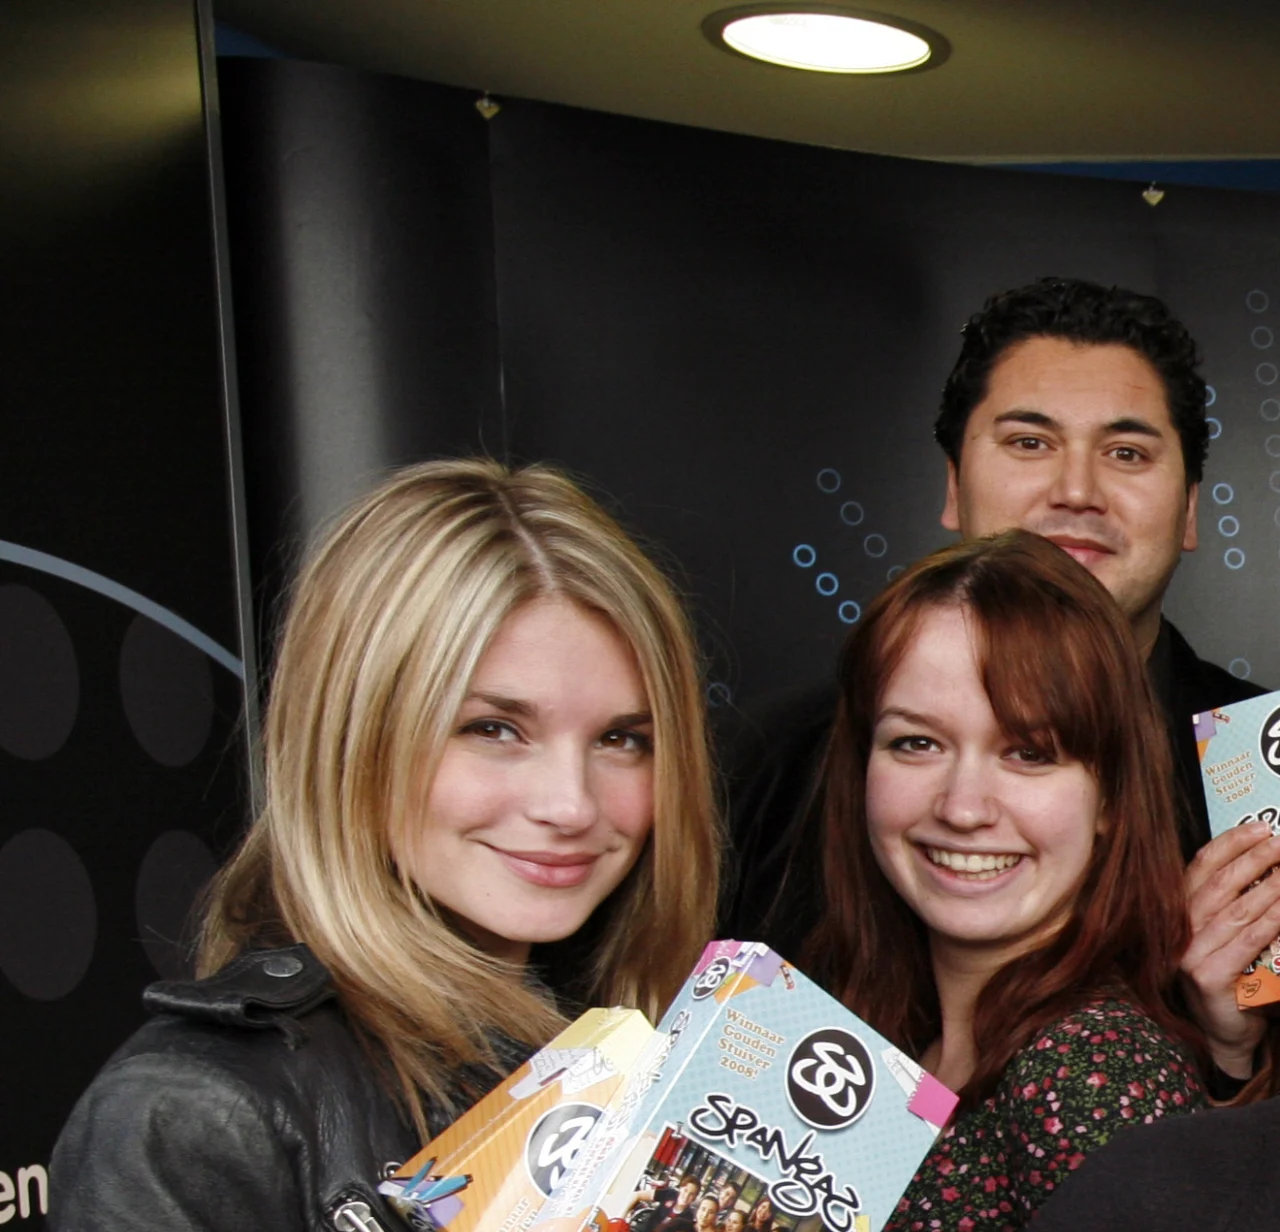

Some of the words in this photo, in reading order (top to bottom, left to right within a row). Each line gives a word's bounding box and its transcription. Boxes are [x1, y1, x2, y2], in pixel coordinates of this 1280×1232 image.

[1205, 751, 1252, 777] Winnaar
[1212, 762, 1253, 786] Gouden
[1215, 773, 1256, 796] Stuiver
[1225, 784, 1254, 803] 2008!
[726, 1009, 785, 1045] Winnaar
[723, 1024, 776, 1057] Gouden
[718, 1038, 770, 1070] Stuiver
[720, 1056, 759, 1081] 2008!
